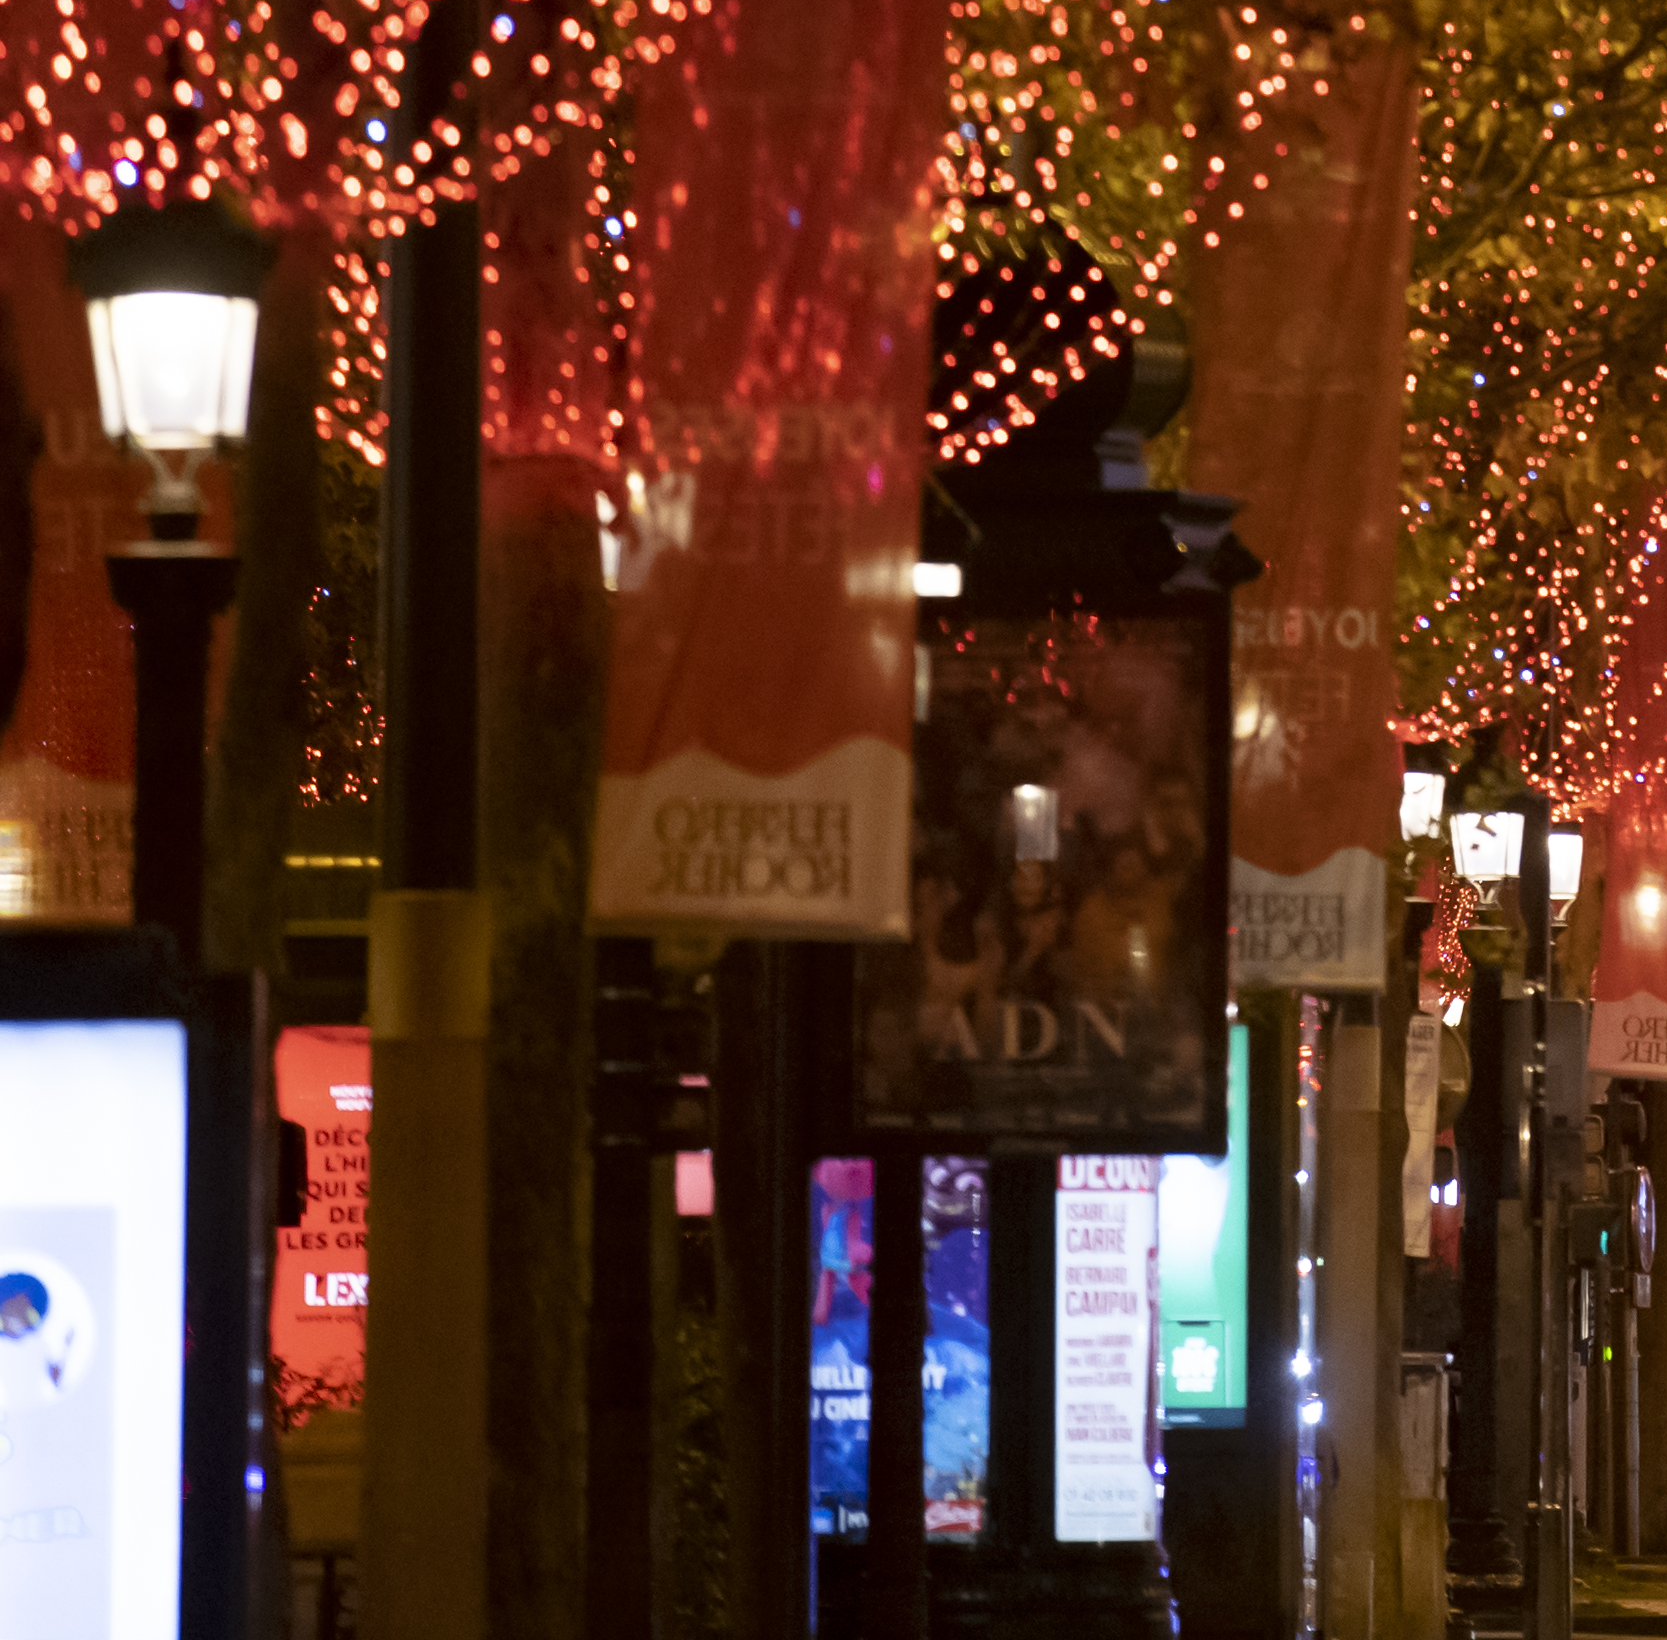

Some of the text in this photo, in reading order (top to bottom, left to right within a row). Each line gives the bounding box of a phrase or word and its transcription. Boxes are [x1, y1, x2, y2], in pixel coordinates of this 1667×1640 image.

[928, 1000, 1127, 1061] ADN
[307, 1180, 346, 1202] QUI
[287, 1232, 328, 1250] LES
